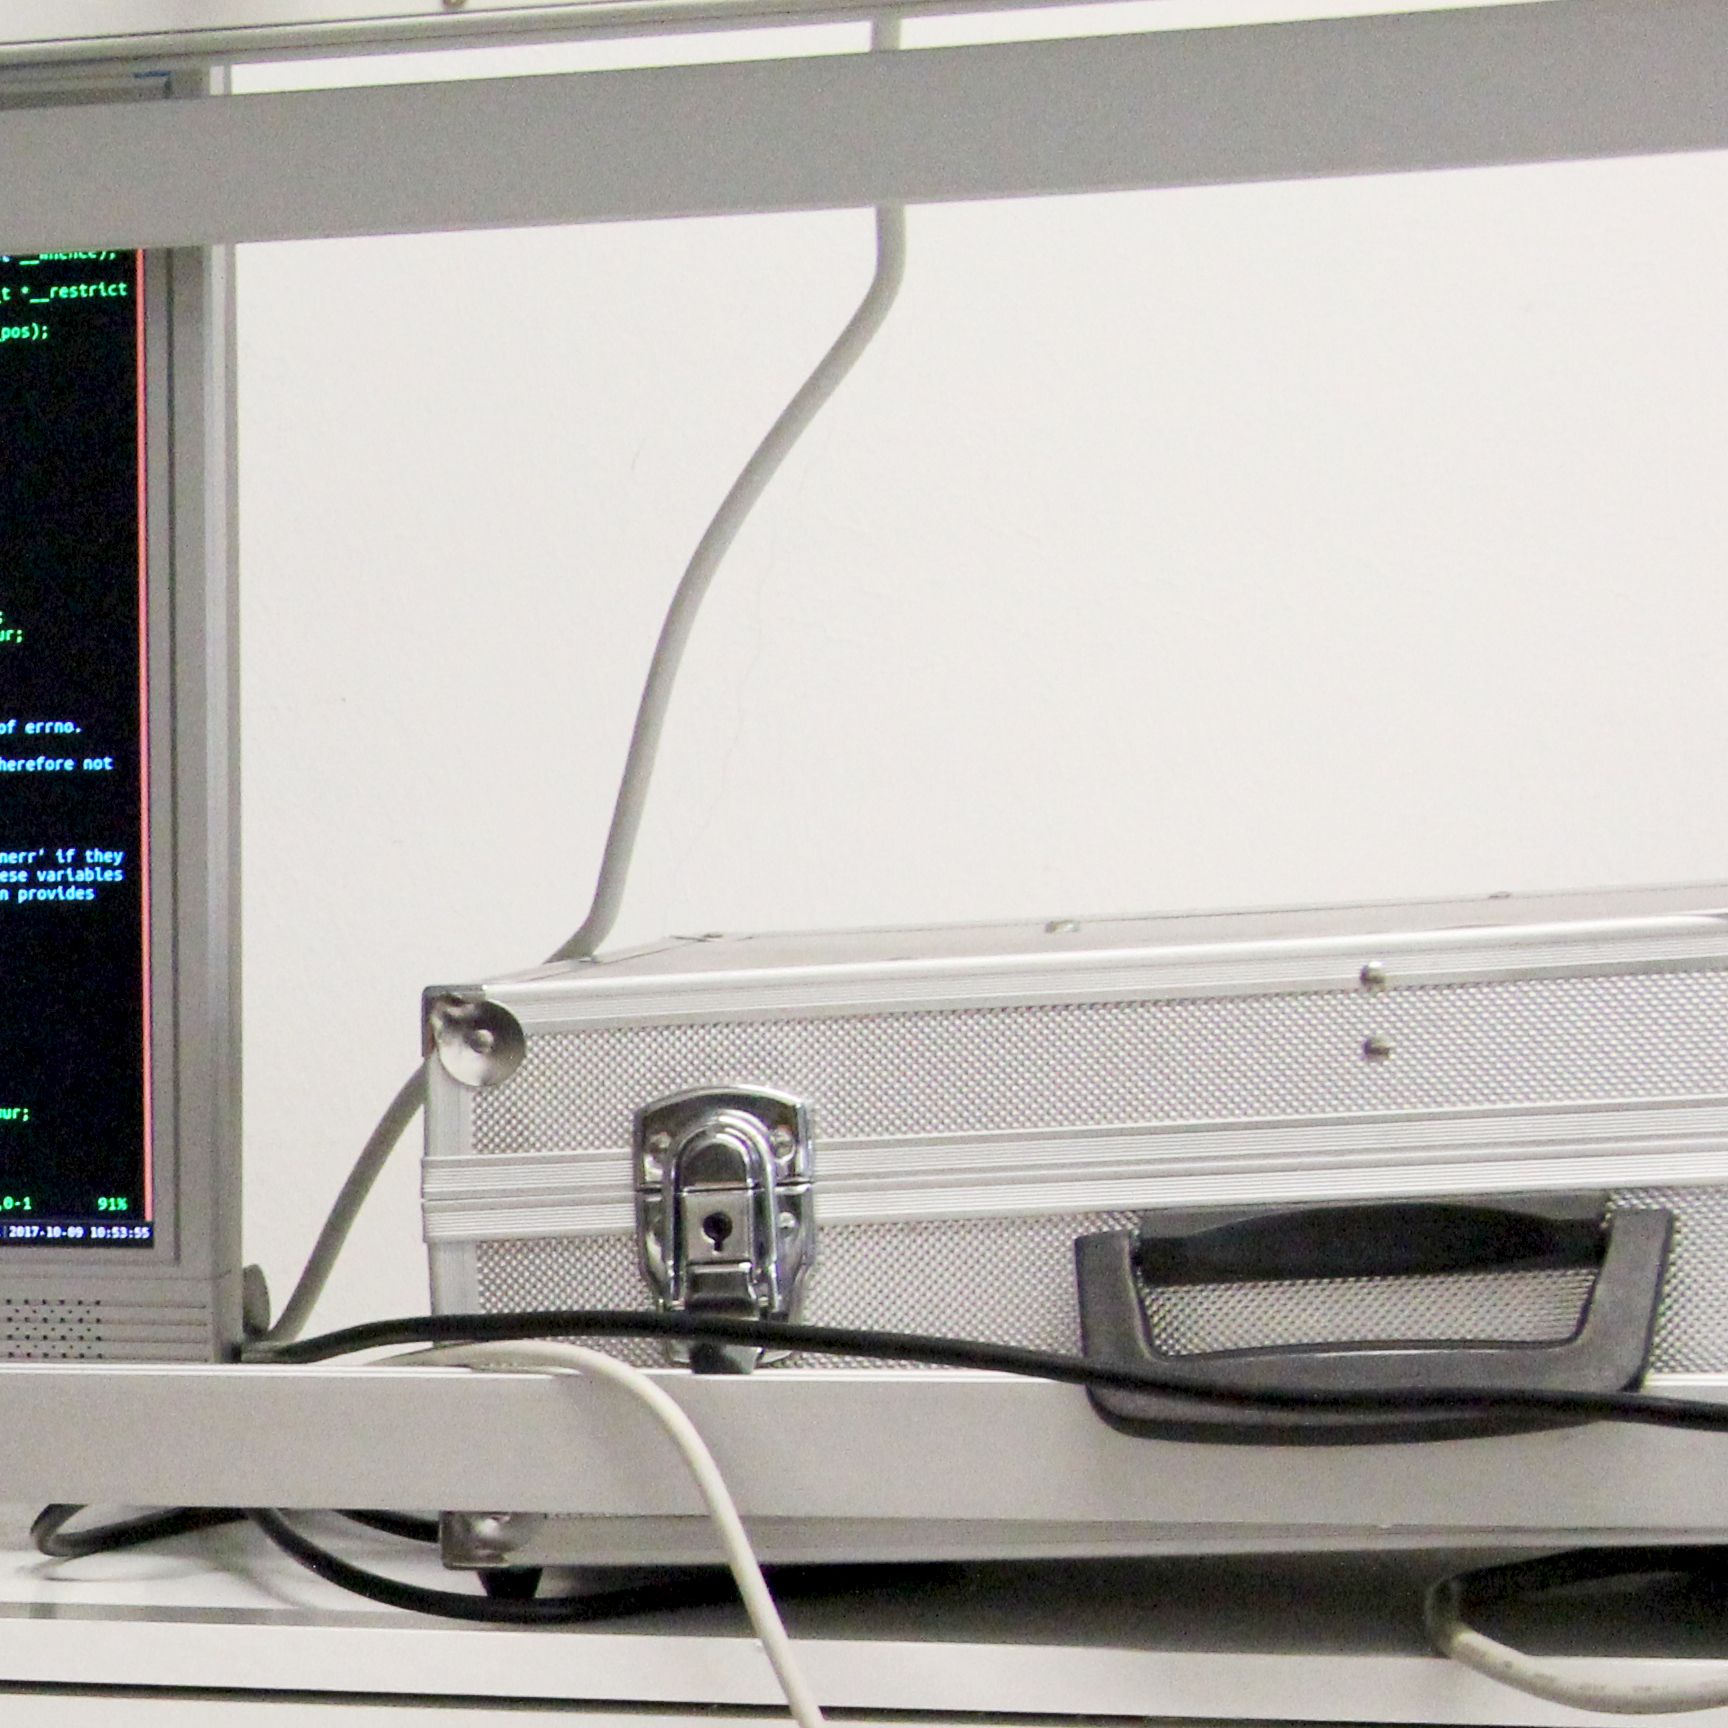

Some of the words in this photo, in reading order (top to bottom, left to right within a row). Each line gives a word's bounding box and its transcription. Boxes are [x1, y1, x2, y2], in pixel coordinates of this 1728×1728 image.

[25, 721, 81, 734] errno.
[83, 756, 113, 770] not
[56, 848, 76, 863] if
[85, 848, 124, 867] they
[98, 1197, 128, 1210] 91%
